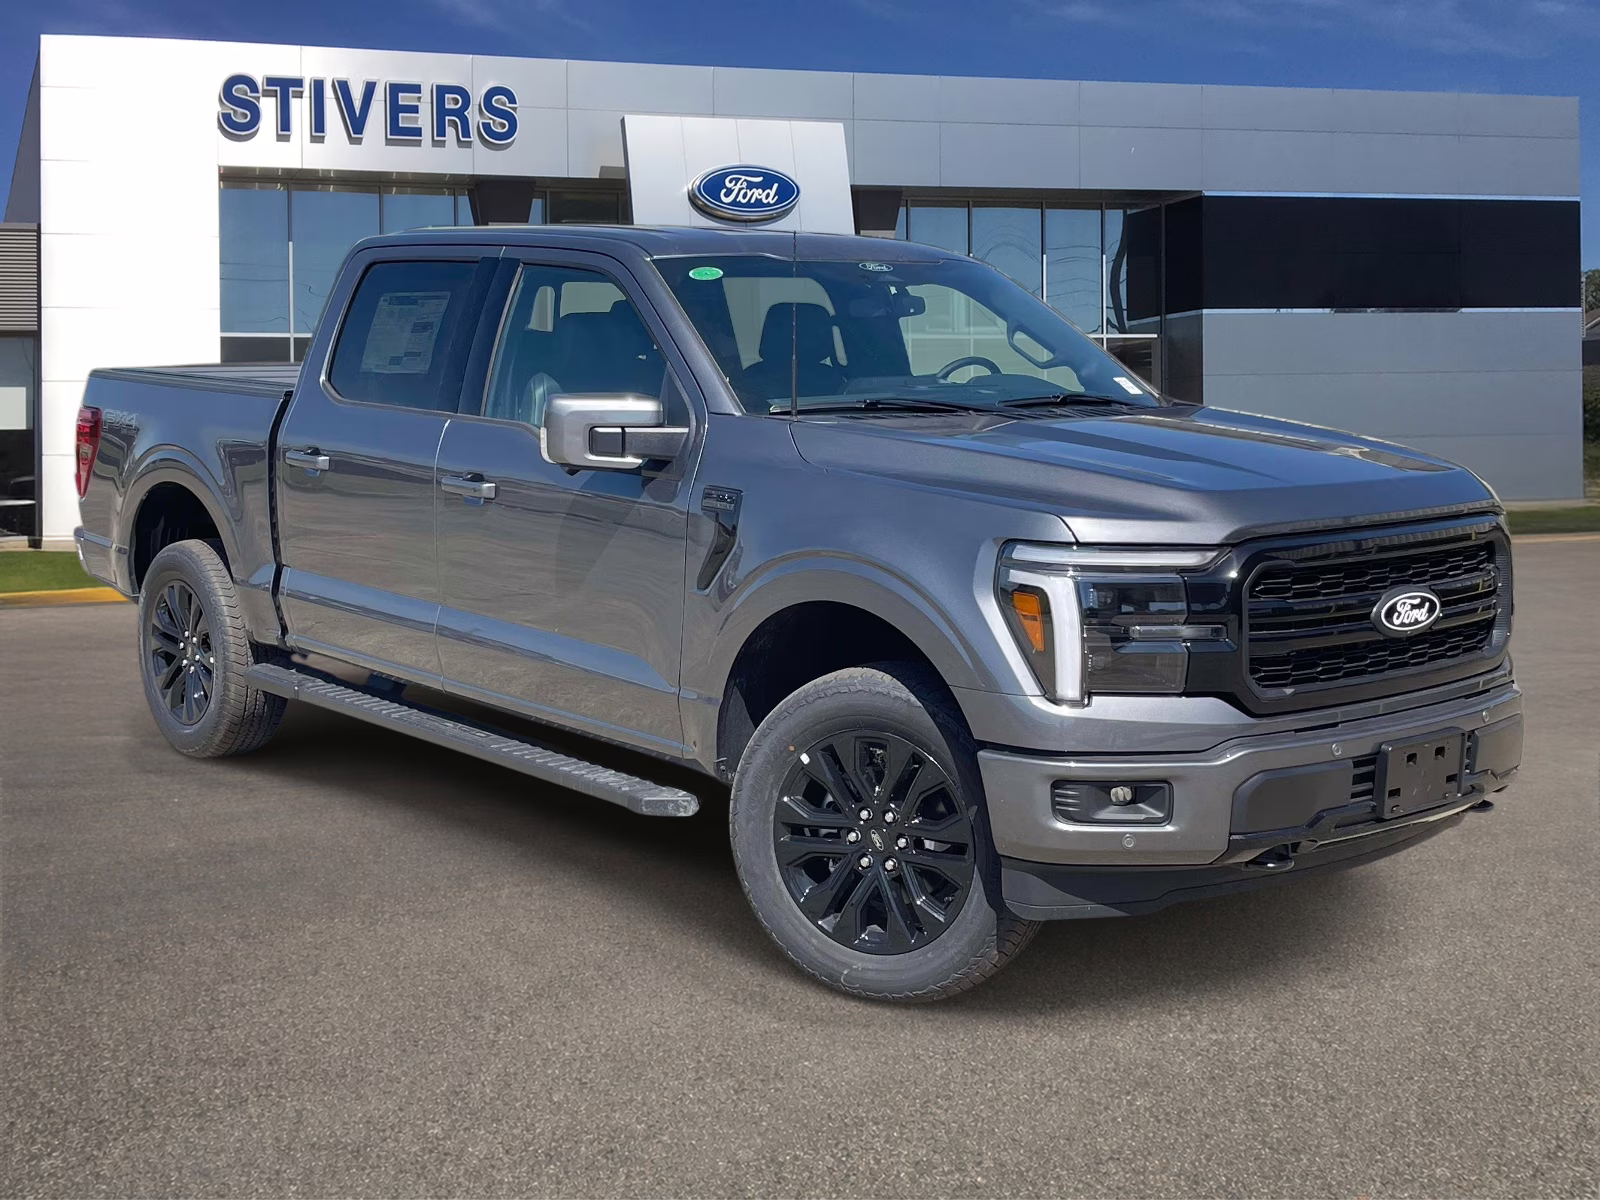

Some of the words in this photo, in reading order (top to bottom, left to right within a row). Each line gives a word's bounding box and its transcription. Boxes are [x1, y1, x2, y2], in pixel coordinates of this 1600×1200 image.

[218, 73, 519, 146] STIVERS
[720, 174, 779, 204] Ford
[1393, 597, 1430, 625] Ford
